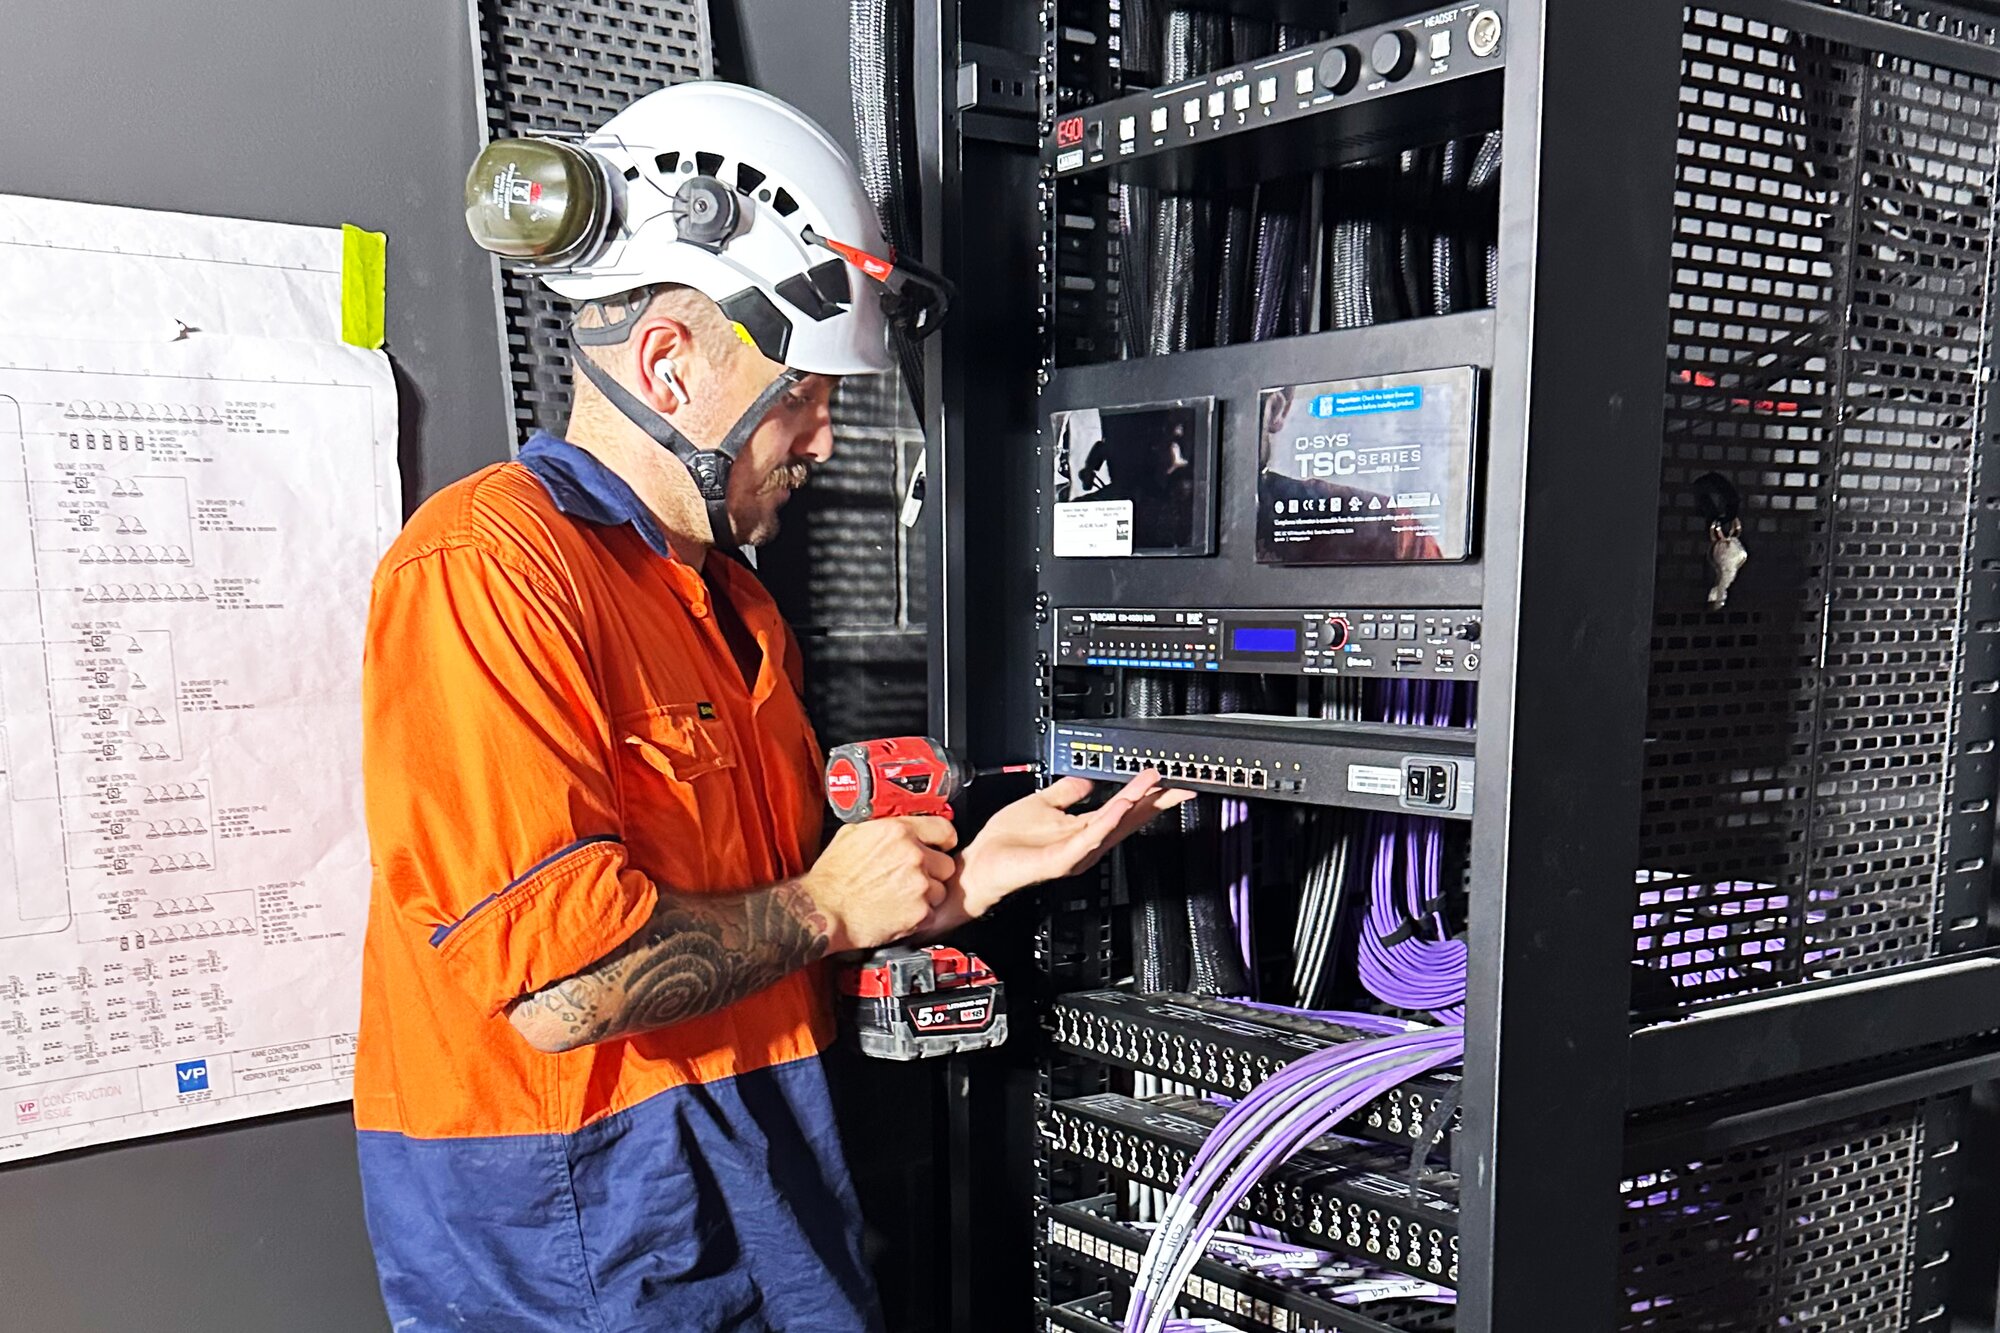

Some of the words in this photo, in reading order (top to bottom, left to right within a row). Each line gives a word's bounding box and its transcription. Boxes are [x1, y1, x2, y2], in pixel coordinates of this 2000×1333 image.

[1425, 9, 1459, 28] HEADSET
[1294, 450, 1357, 478] TSC
[1357, 450, 1421, 466] SERIES
[1089, 612, 1117, 623] TASCAM
[828, 775, 856, 785] FUEL
[917, 1007, 945, 1027] 5.0
[962, 1009, 983, 1018] M18
[268, 1043, 311, 1056] CONSTRUCTION
[178, 1067, 206, 1081] VP
[268, 1068, 284, 1078] STATE
[285, 1066, 300, 1075] HIGH
[300, 1063, 323, 1073] SCHOOL
[42, 1085, 122, 1108] CONSTRUCTION
[19, 1102, 35, 1113] VP
[44, 1106, 73, 1121] ISSUE
